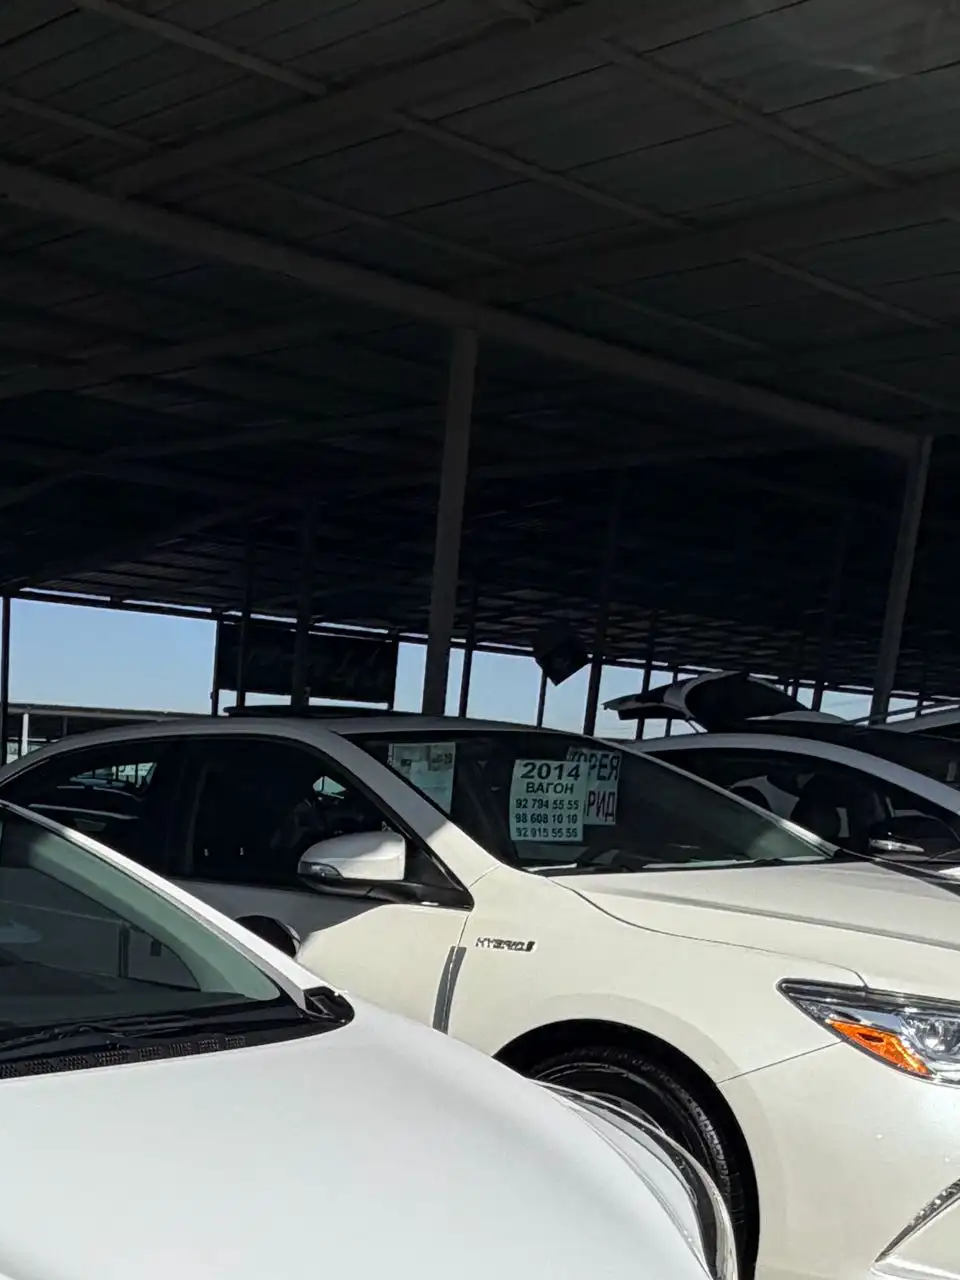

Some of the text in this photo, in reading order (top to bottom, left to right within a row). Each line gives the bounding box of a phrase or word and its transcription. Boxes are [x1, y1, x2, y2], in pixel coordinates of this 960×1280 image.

[520, 762, 581, 781] 2014
[525, 782, 574, 795] ВАГОН
[515, 798, 528, 809] 92
[567, 799, 580, 810] 55
[583, 790, 616, 822] РИД
[515, 813, 578, 824] 98 608 10 10
[515, 827, 528, 837] 92
